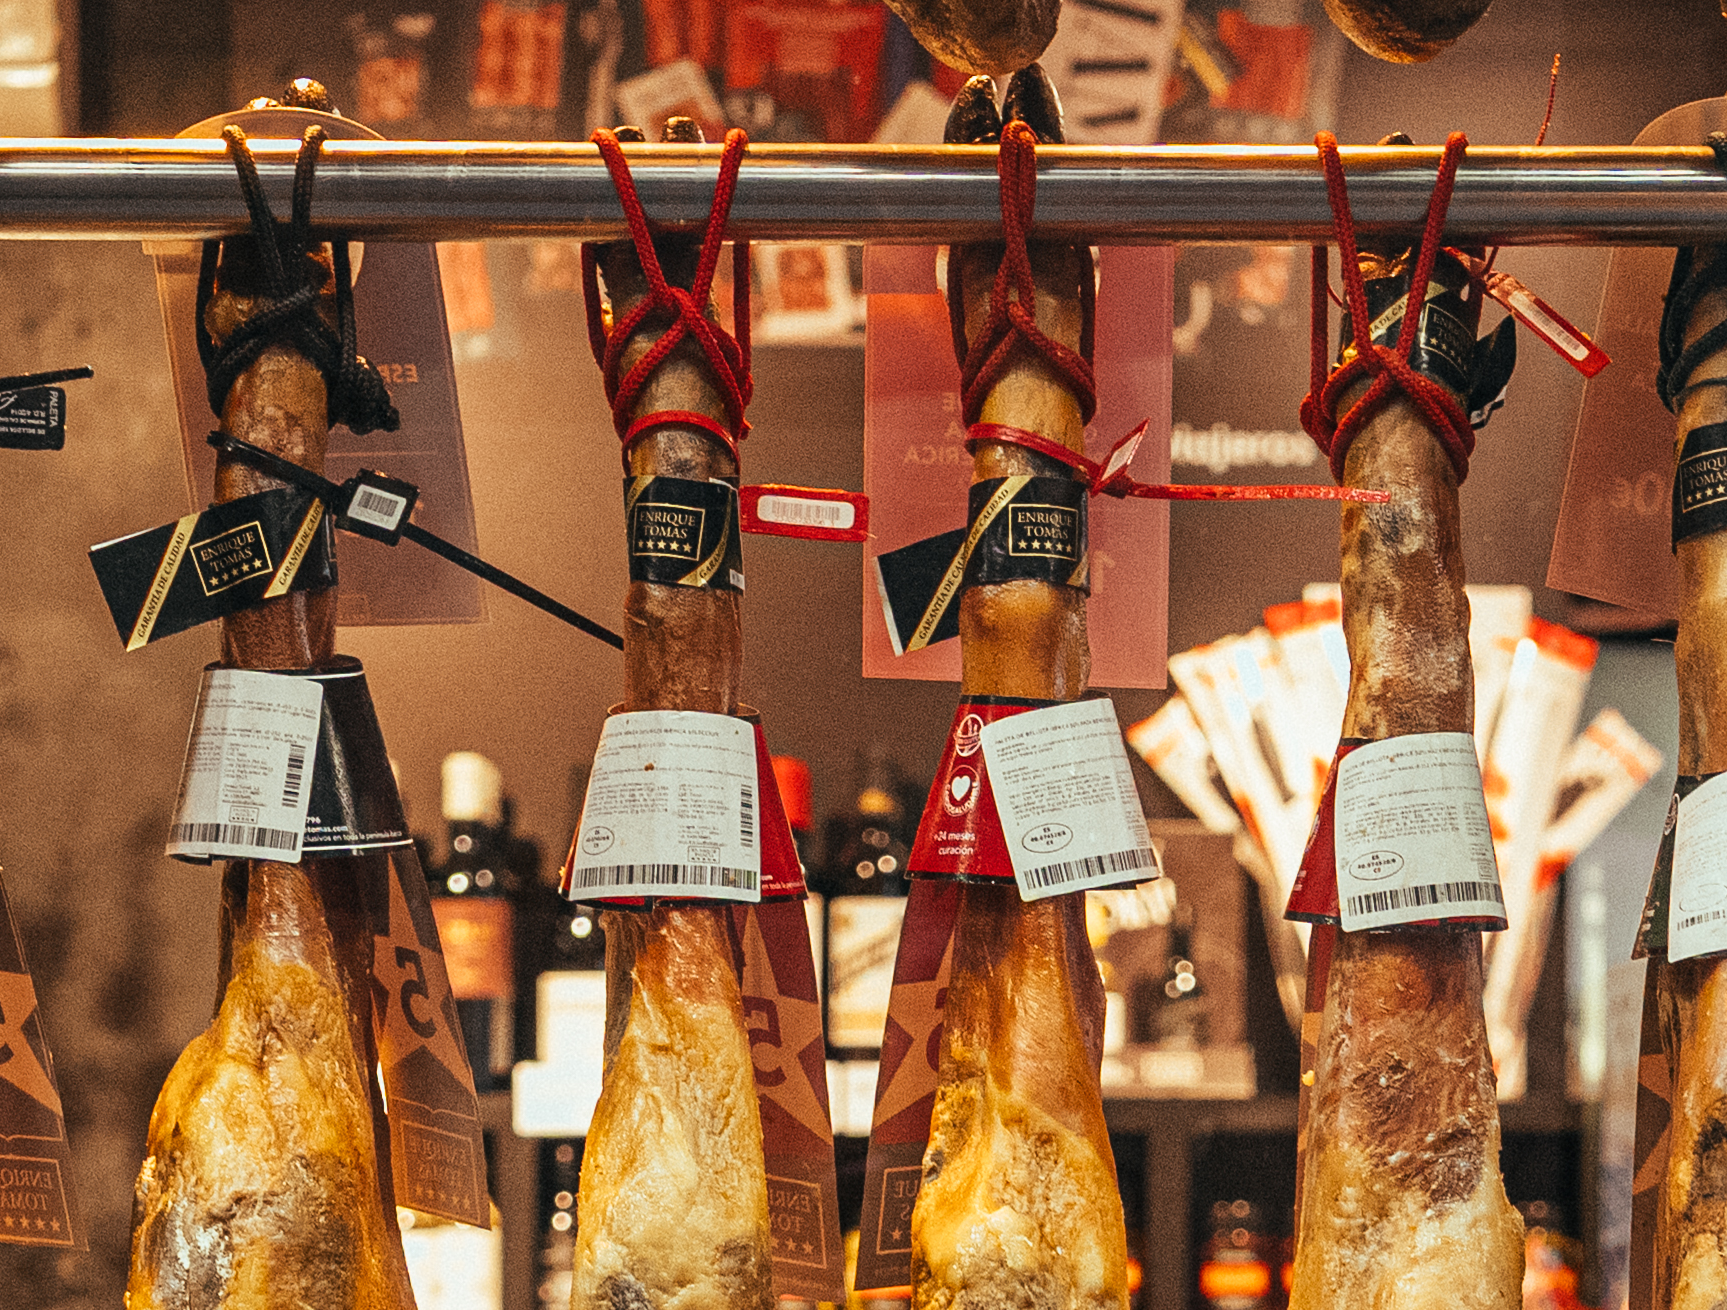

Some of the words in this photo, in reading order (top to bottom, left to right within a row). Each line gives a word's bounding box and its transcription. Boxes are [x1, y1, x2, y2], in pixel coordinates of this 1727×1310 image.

[639, 509, 696, 529] ENRIQUE
[1017, 510, 1073, 530] ENRIQUE
[199, 530, 256, 562] ENRIQUE
